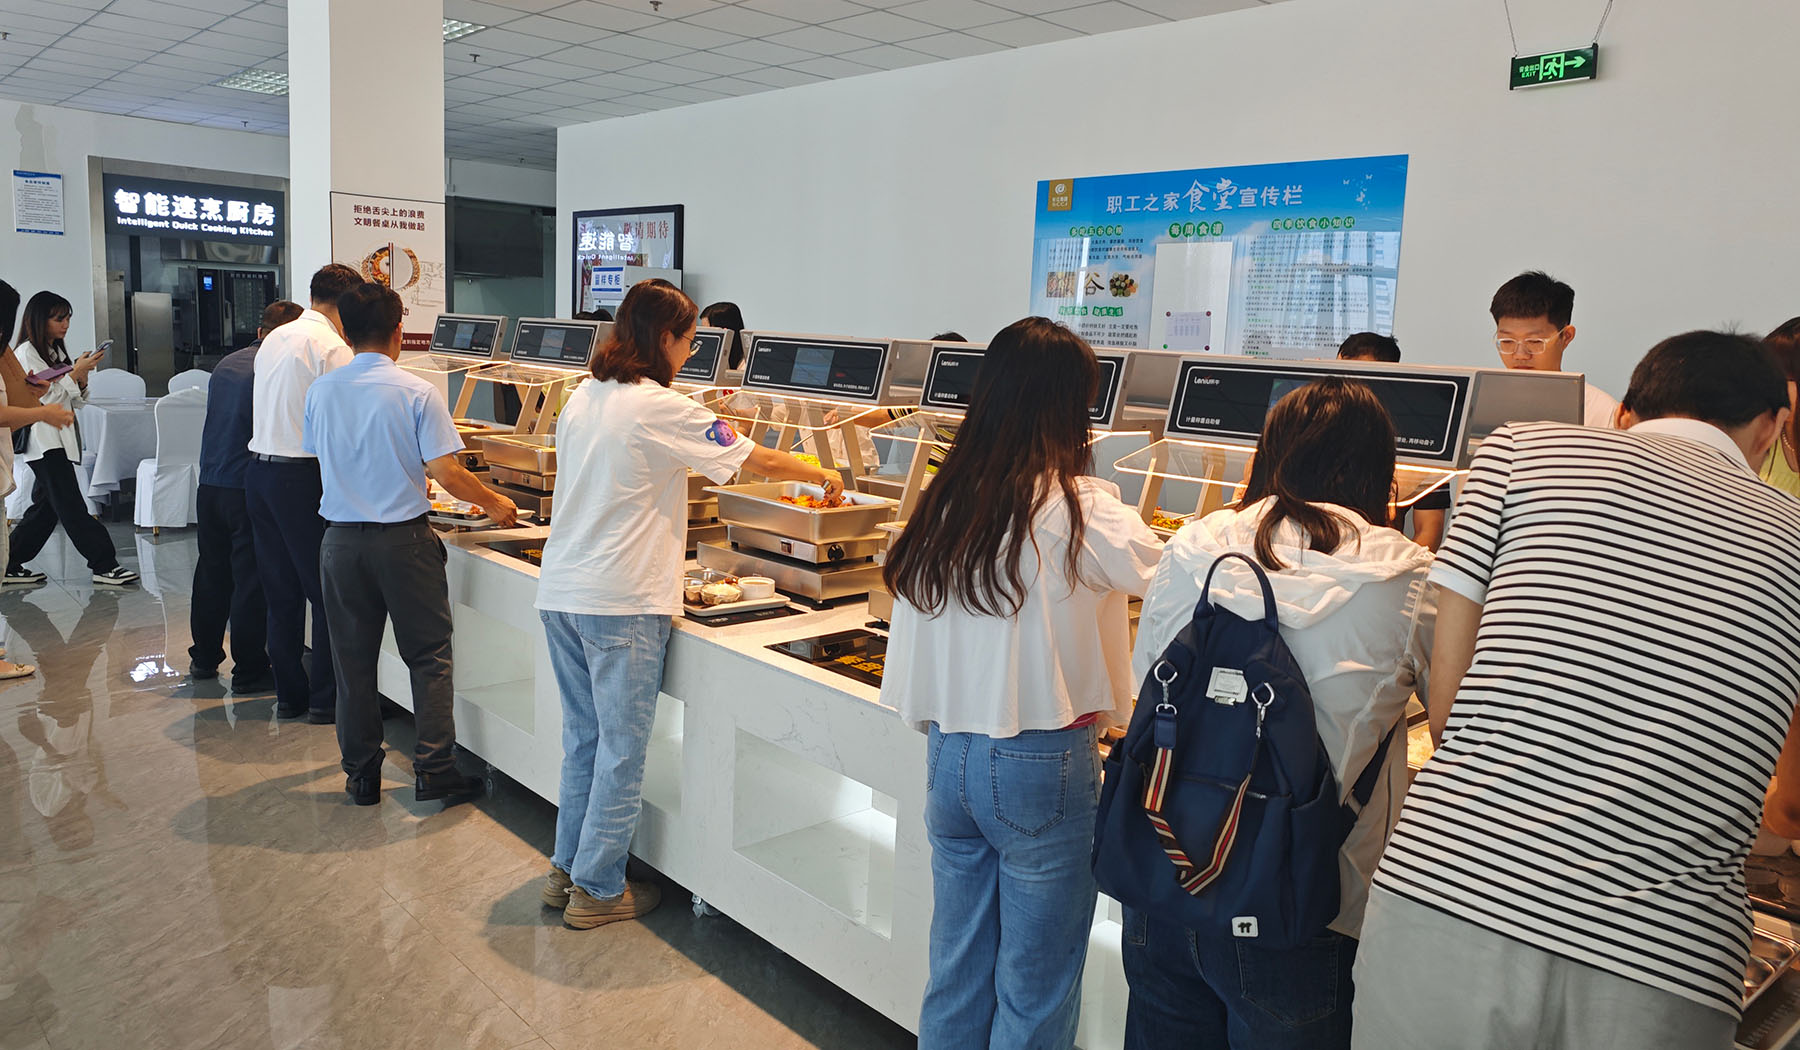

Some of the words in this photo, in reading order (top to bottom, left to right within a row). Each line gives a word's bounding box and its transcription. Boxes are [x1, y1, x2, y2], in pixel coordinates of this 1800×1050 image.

[1521, 70, 1536, 78] EXIT
[1106, 177, 1303, 214] 职工之家食堂宣传栏
[114, 188, 276, 226] 智能速烹厨房
[353, 204, 425, 219] 拒绝舌尖上的浪费
[117, 216, 170, 229] Intelligent
[172, 220, 199, 231] Quick
[201, 223, 238, 235] Cooking
[239, 227, 274, 237] Kitchen
[353, 217, 425, 231] 文明餐桌从我做起
[1170, 221, 1223, 238] 每周食谱
